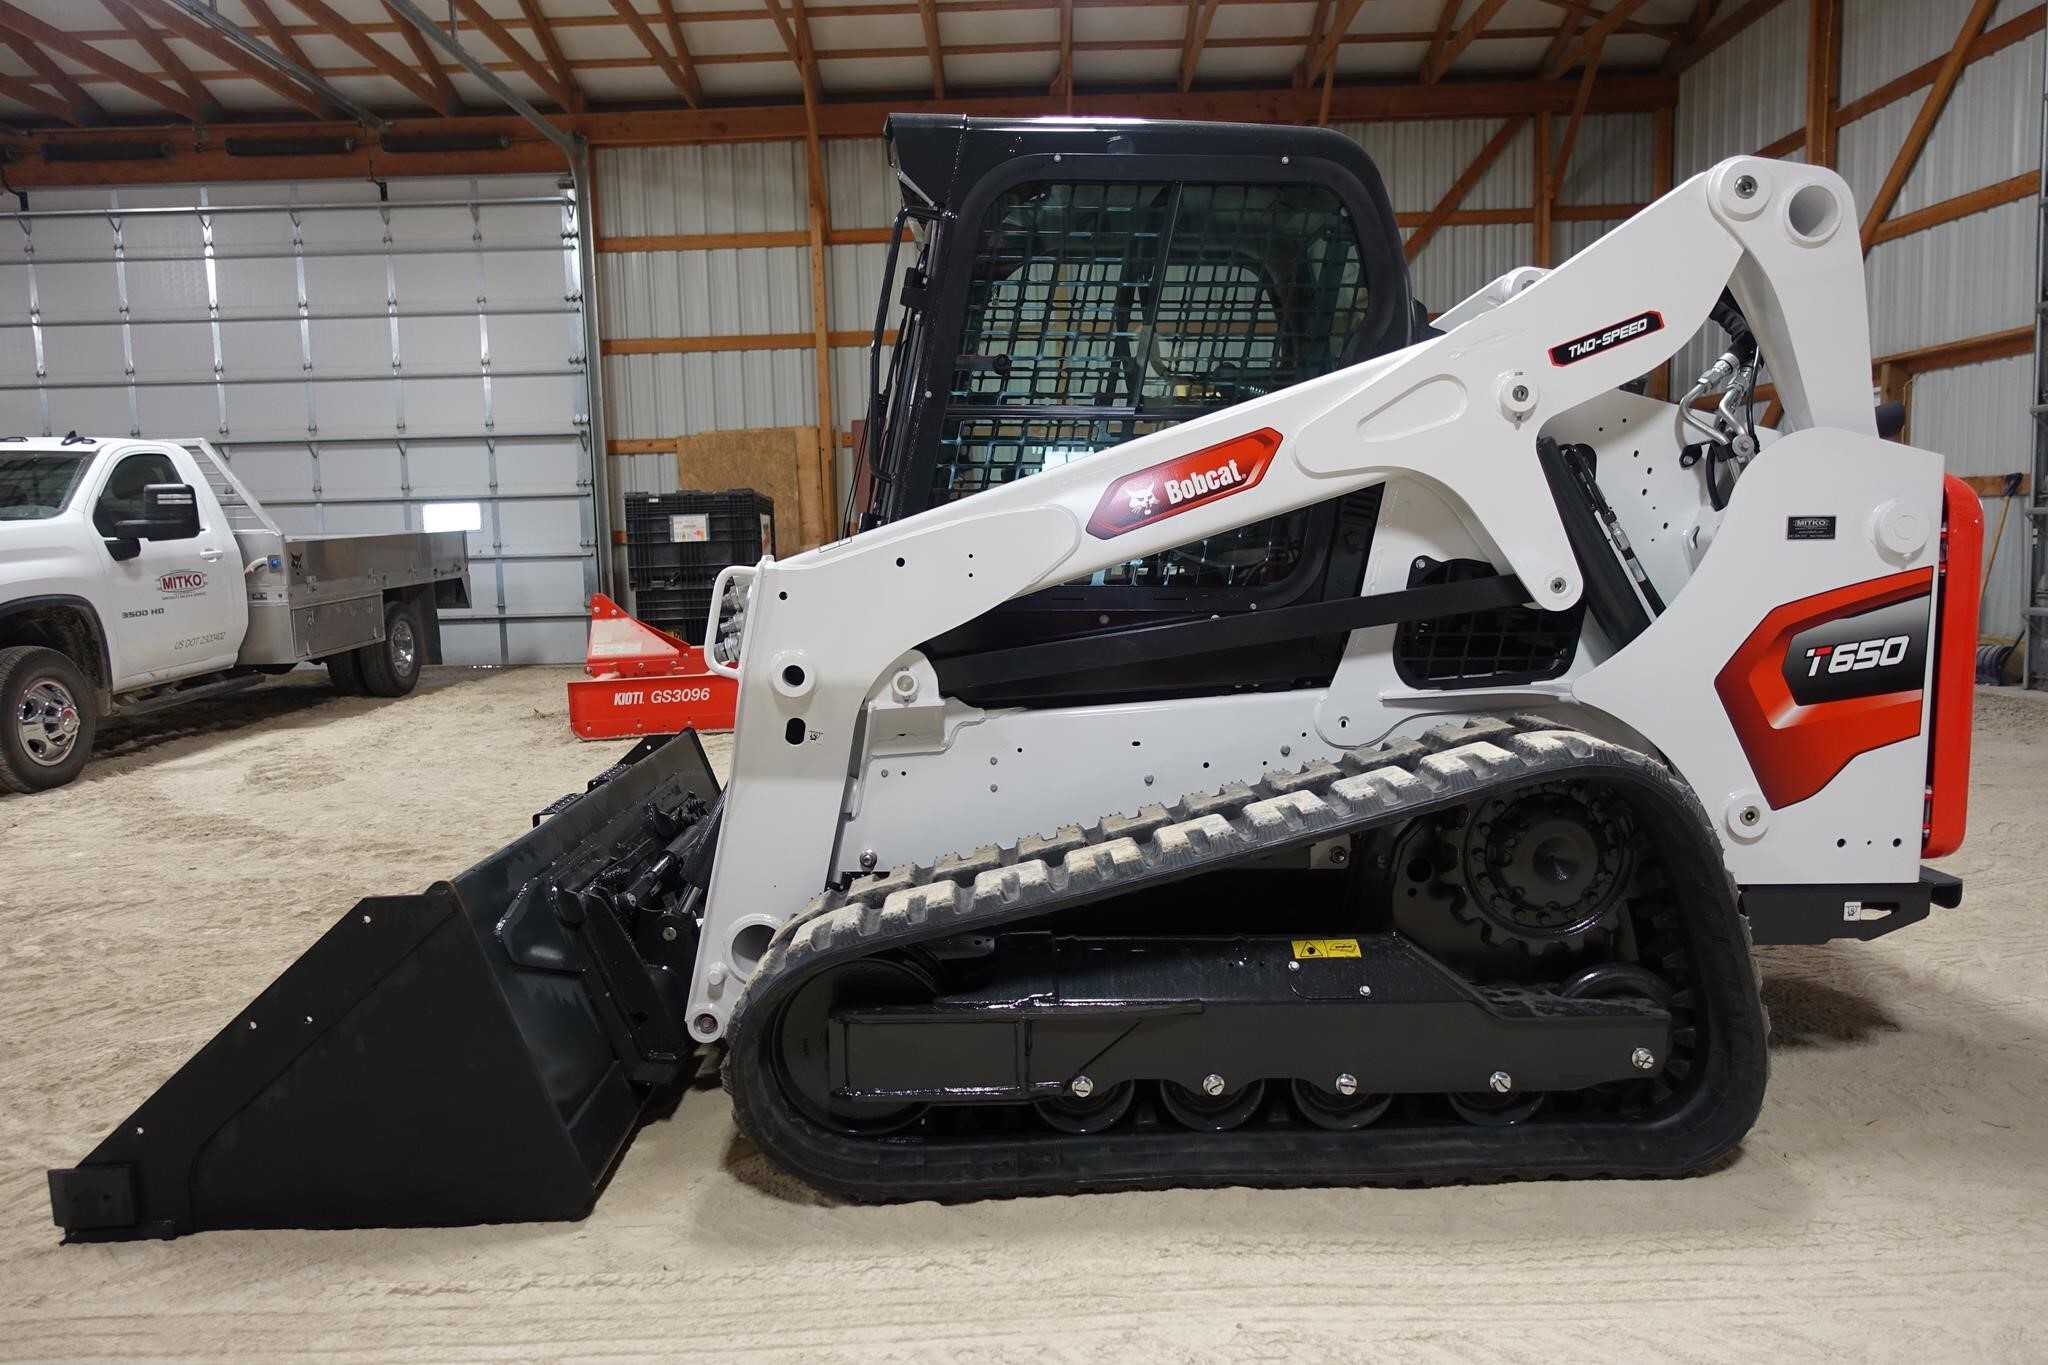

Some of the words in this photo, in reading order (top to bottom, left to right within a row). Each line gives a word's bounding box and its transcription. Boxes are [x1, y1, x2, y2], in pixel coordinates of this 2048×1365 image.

[1568, 318, 1648, 358] TWO-SPEED
[1164, 459, 1243, 504] Bobcat
[1796, 519, 1826, 527] MITKO
[162, 574, 202, 590] MITKO
[122, 609, 149, 619] 3500
[151, 608, 165, 616] HD
[174, 640, 185, 650] US
[185, 637, 200, 648] DOT
[1806, 635, 1910, 677] T650
[614, 691, 643, 706] KIOTI
[650, 687, 711, 704] GS3096
